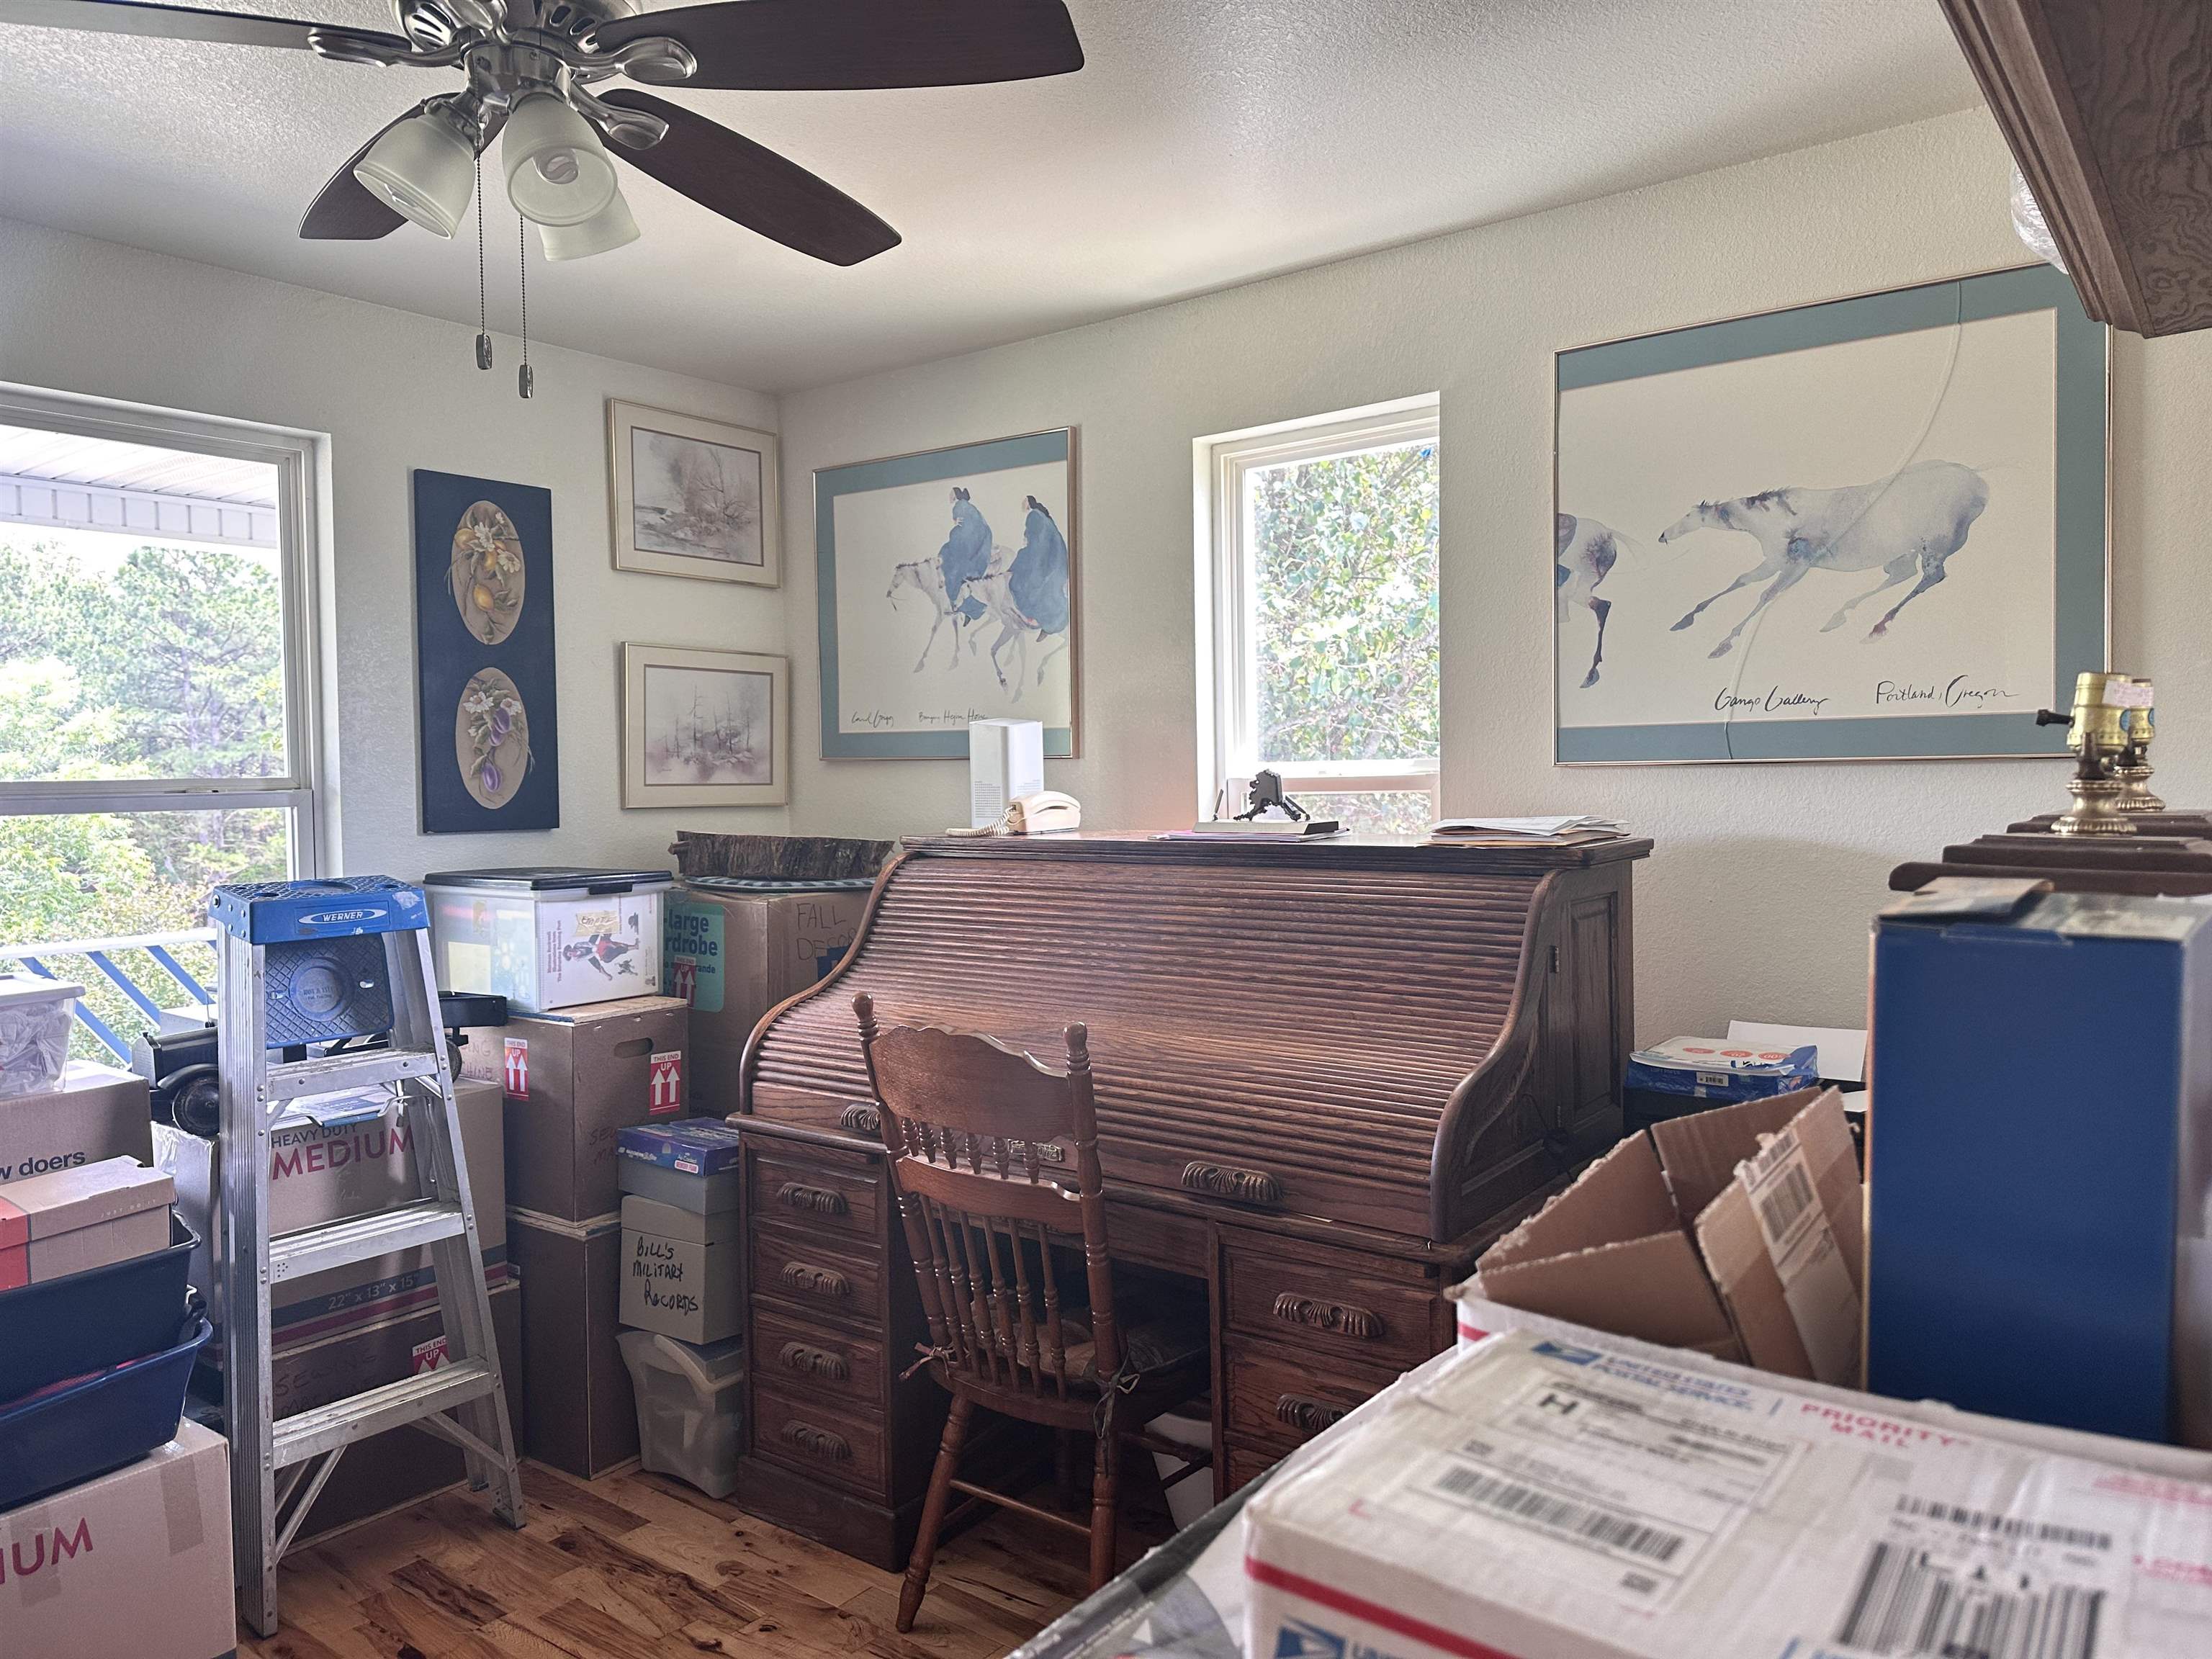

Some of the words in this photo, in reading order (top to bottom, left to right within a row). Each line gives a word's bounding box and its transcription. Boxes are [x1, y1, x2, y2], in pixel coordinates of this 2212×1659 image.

[323, 910, 364, 922] WERNER
[663, 909, 709, 936] -large
[796, 903, 847, 930] FALL
[665, 932, 718, 956] rdrobe
[511, 1048, 521, 1057] UP
[660, 1062, 672, 1071] UP
[271, 1128, 319, 1148] HEAVY
[321, 1123, 357, 1138] DUTY
[19, 1151, 86, 1177] doers
[272, 1124, 415, 1180] MEDIUM
[101, 1208, 123, 1218] JUST
[366, 1282, 386, 1298] 13"
[389, 1282, 396, 1292] x
[415, 1344, 431, 1354] THIS
[426, 1349, 439, 1361] UP
[1800, 1403, 1956, 1447] PRIORITY
[1830, 1421, 1908, 1448] MAIL
[0, 1517, 94, 1584] IUM
